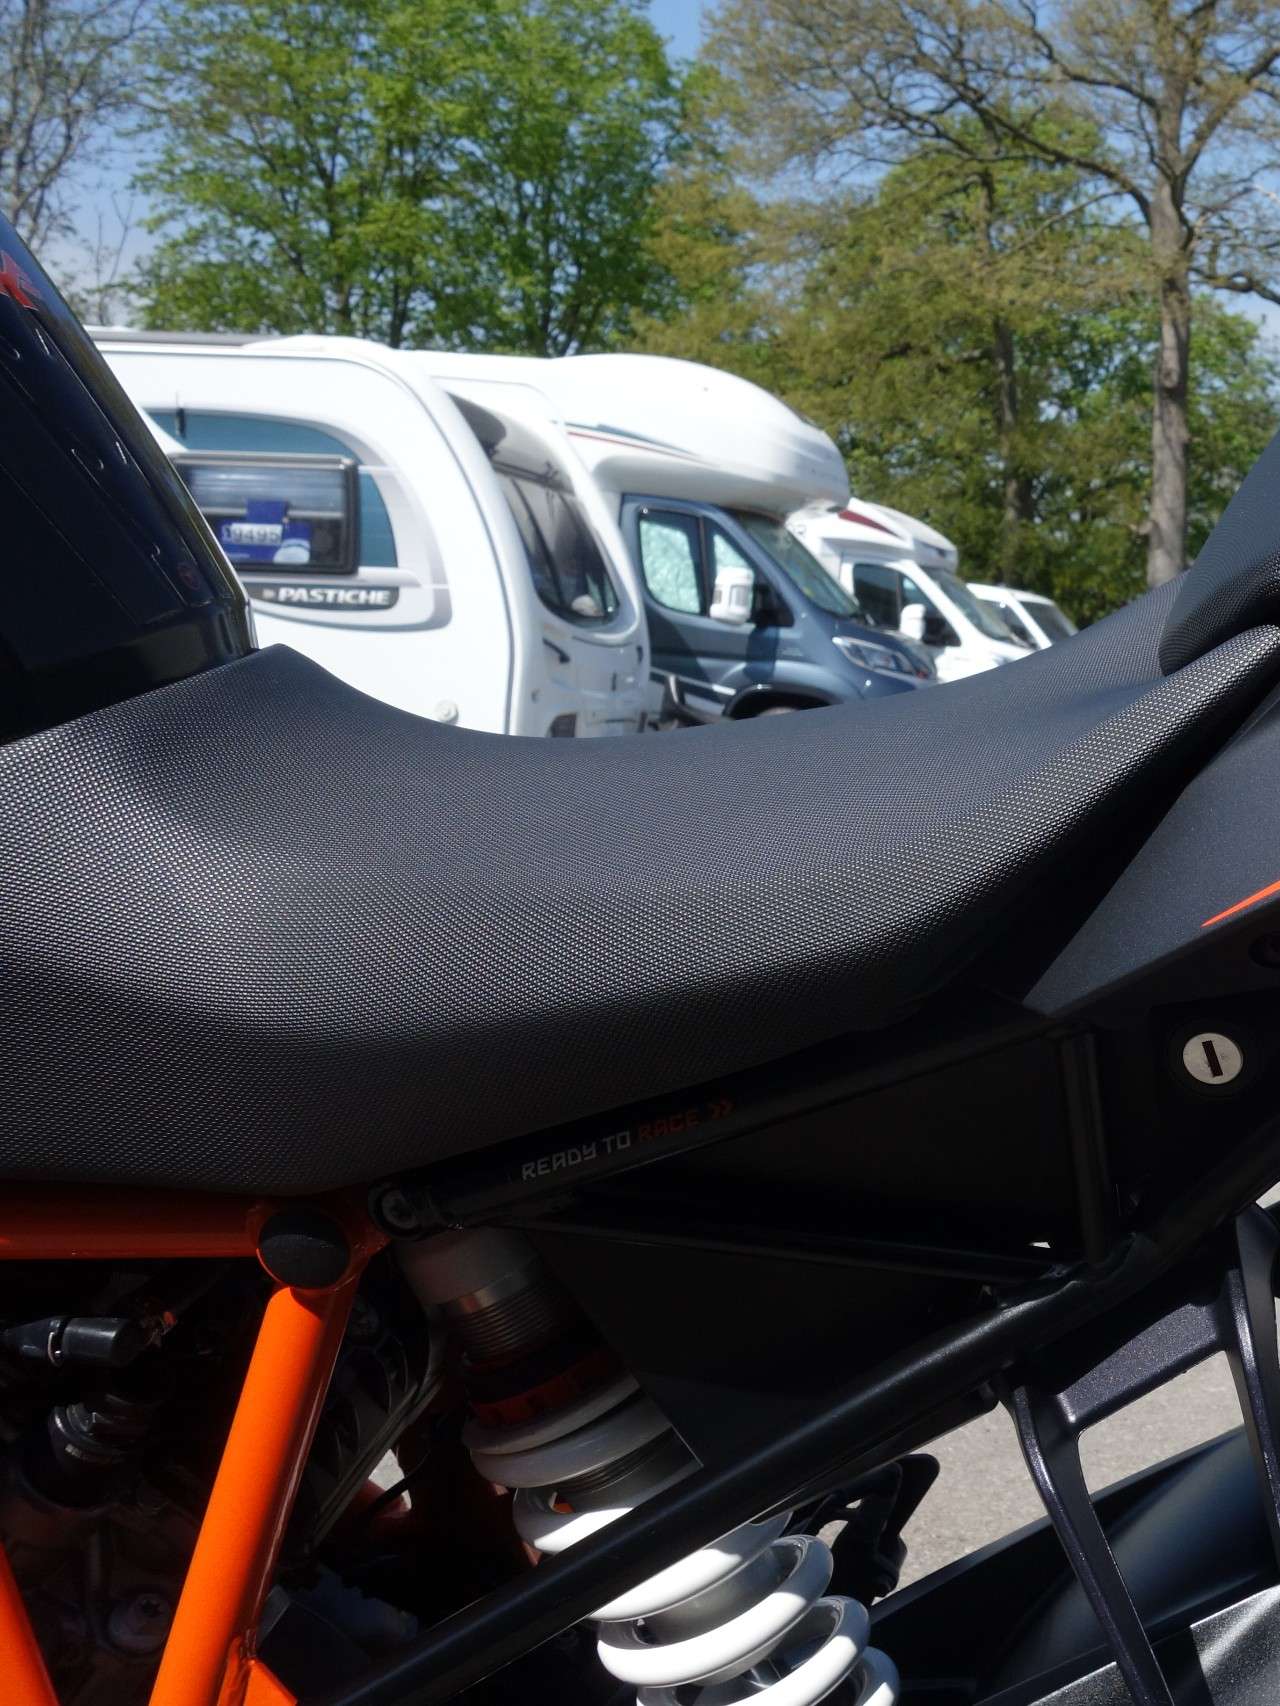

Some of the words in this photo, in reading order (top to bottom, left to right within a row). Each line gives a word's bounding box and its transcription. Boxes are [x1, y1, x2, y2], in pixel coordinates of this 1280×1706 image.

[278, 587, 391, 605] PASTICHE
[520, 1143, 597, 1181] READY
[602, 1131, 631, 1155] TO
[637, 1110, 701, 1142] RACE
